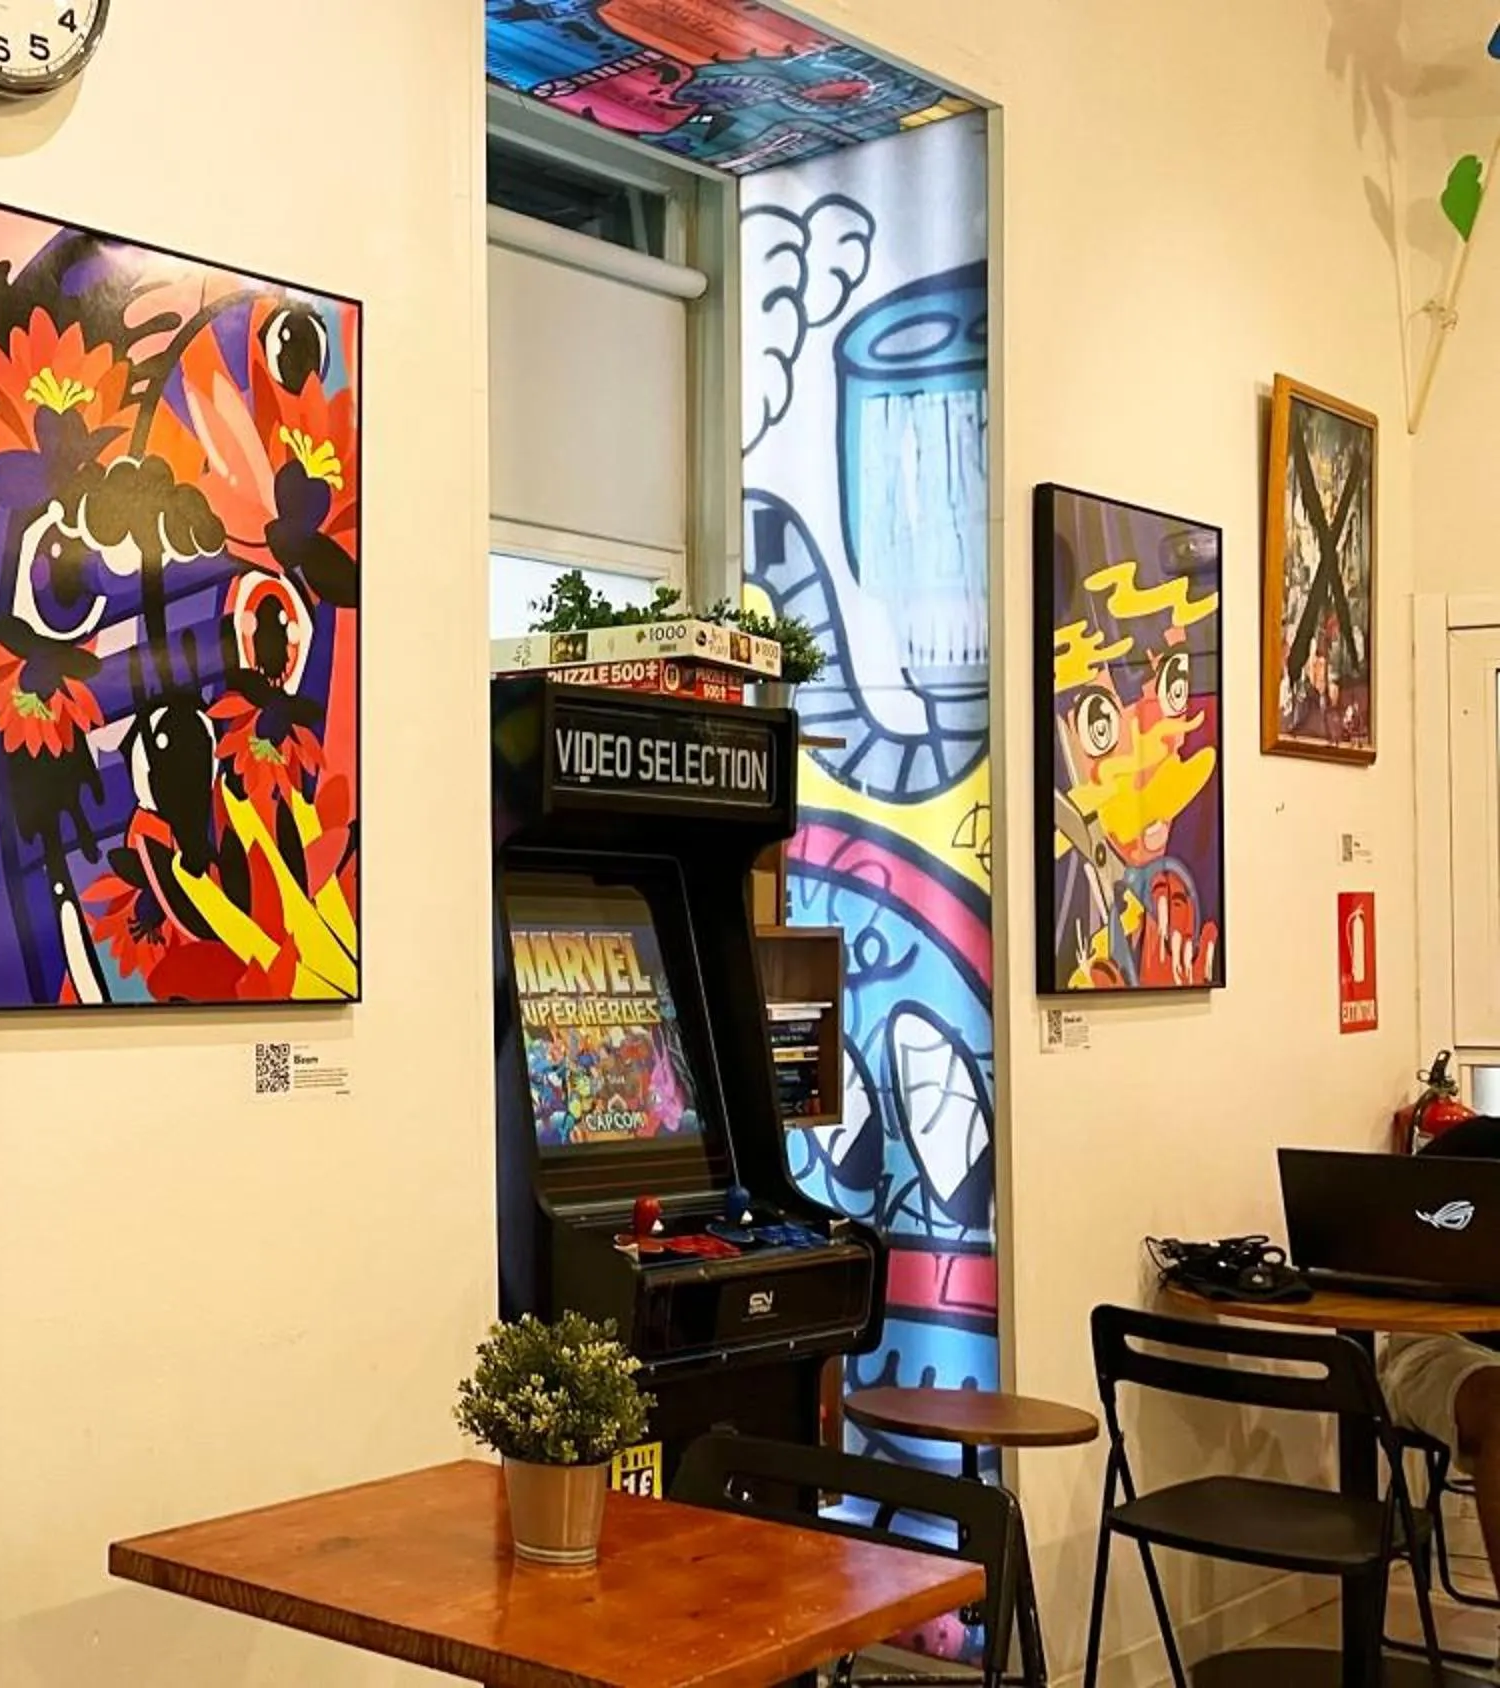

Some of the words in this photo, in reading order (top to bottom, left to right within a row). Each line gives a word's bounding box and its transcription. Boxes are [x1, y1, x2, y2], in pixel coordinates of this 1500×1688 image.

[57, 8, 78, 33] 4
[29, 33, 51, 61] 5
[649, 625, 687, 643] 1000
[611, 661, 645, 683] 500
[556, 727, 632, 779] VIDEO
[638, 737, 768, 792] SELECTION
[510, 930, 653, 996] MARVEL
[522, 998, 578, 1026] UPER
[585, 1111, 646, 1132] CAPCOM
